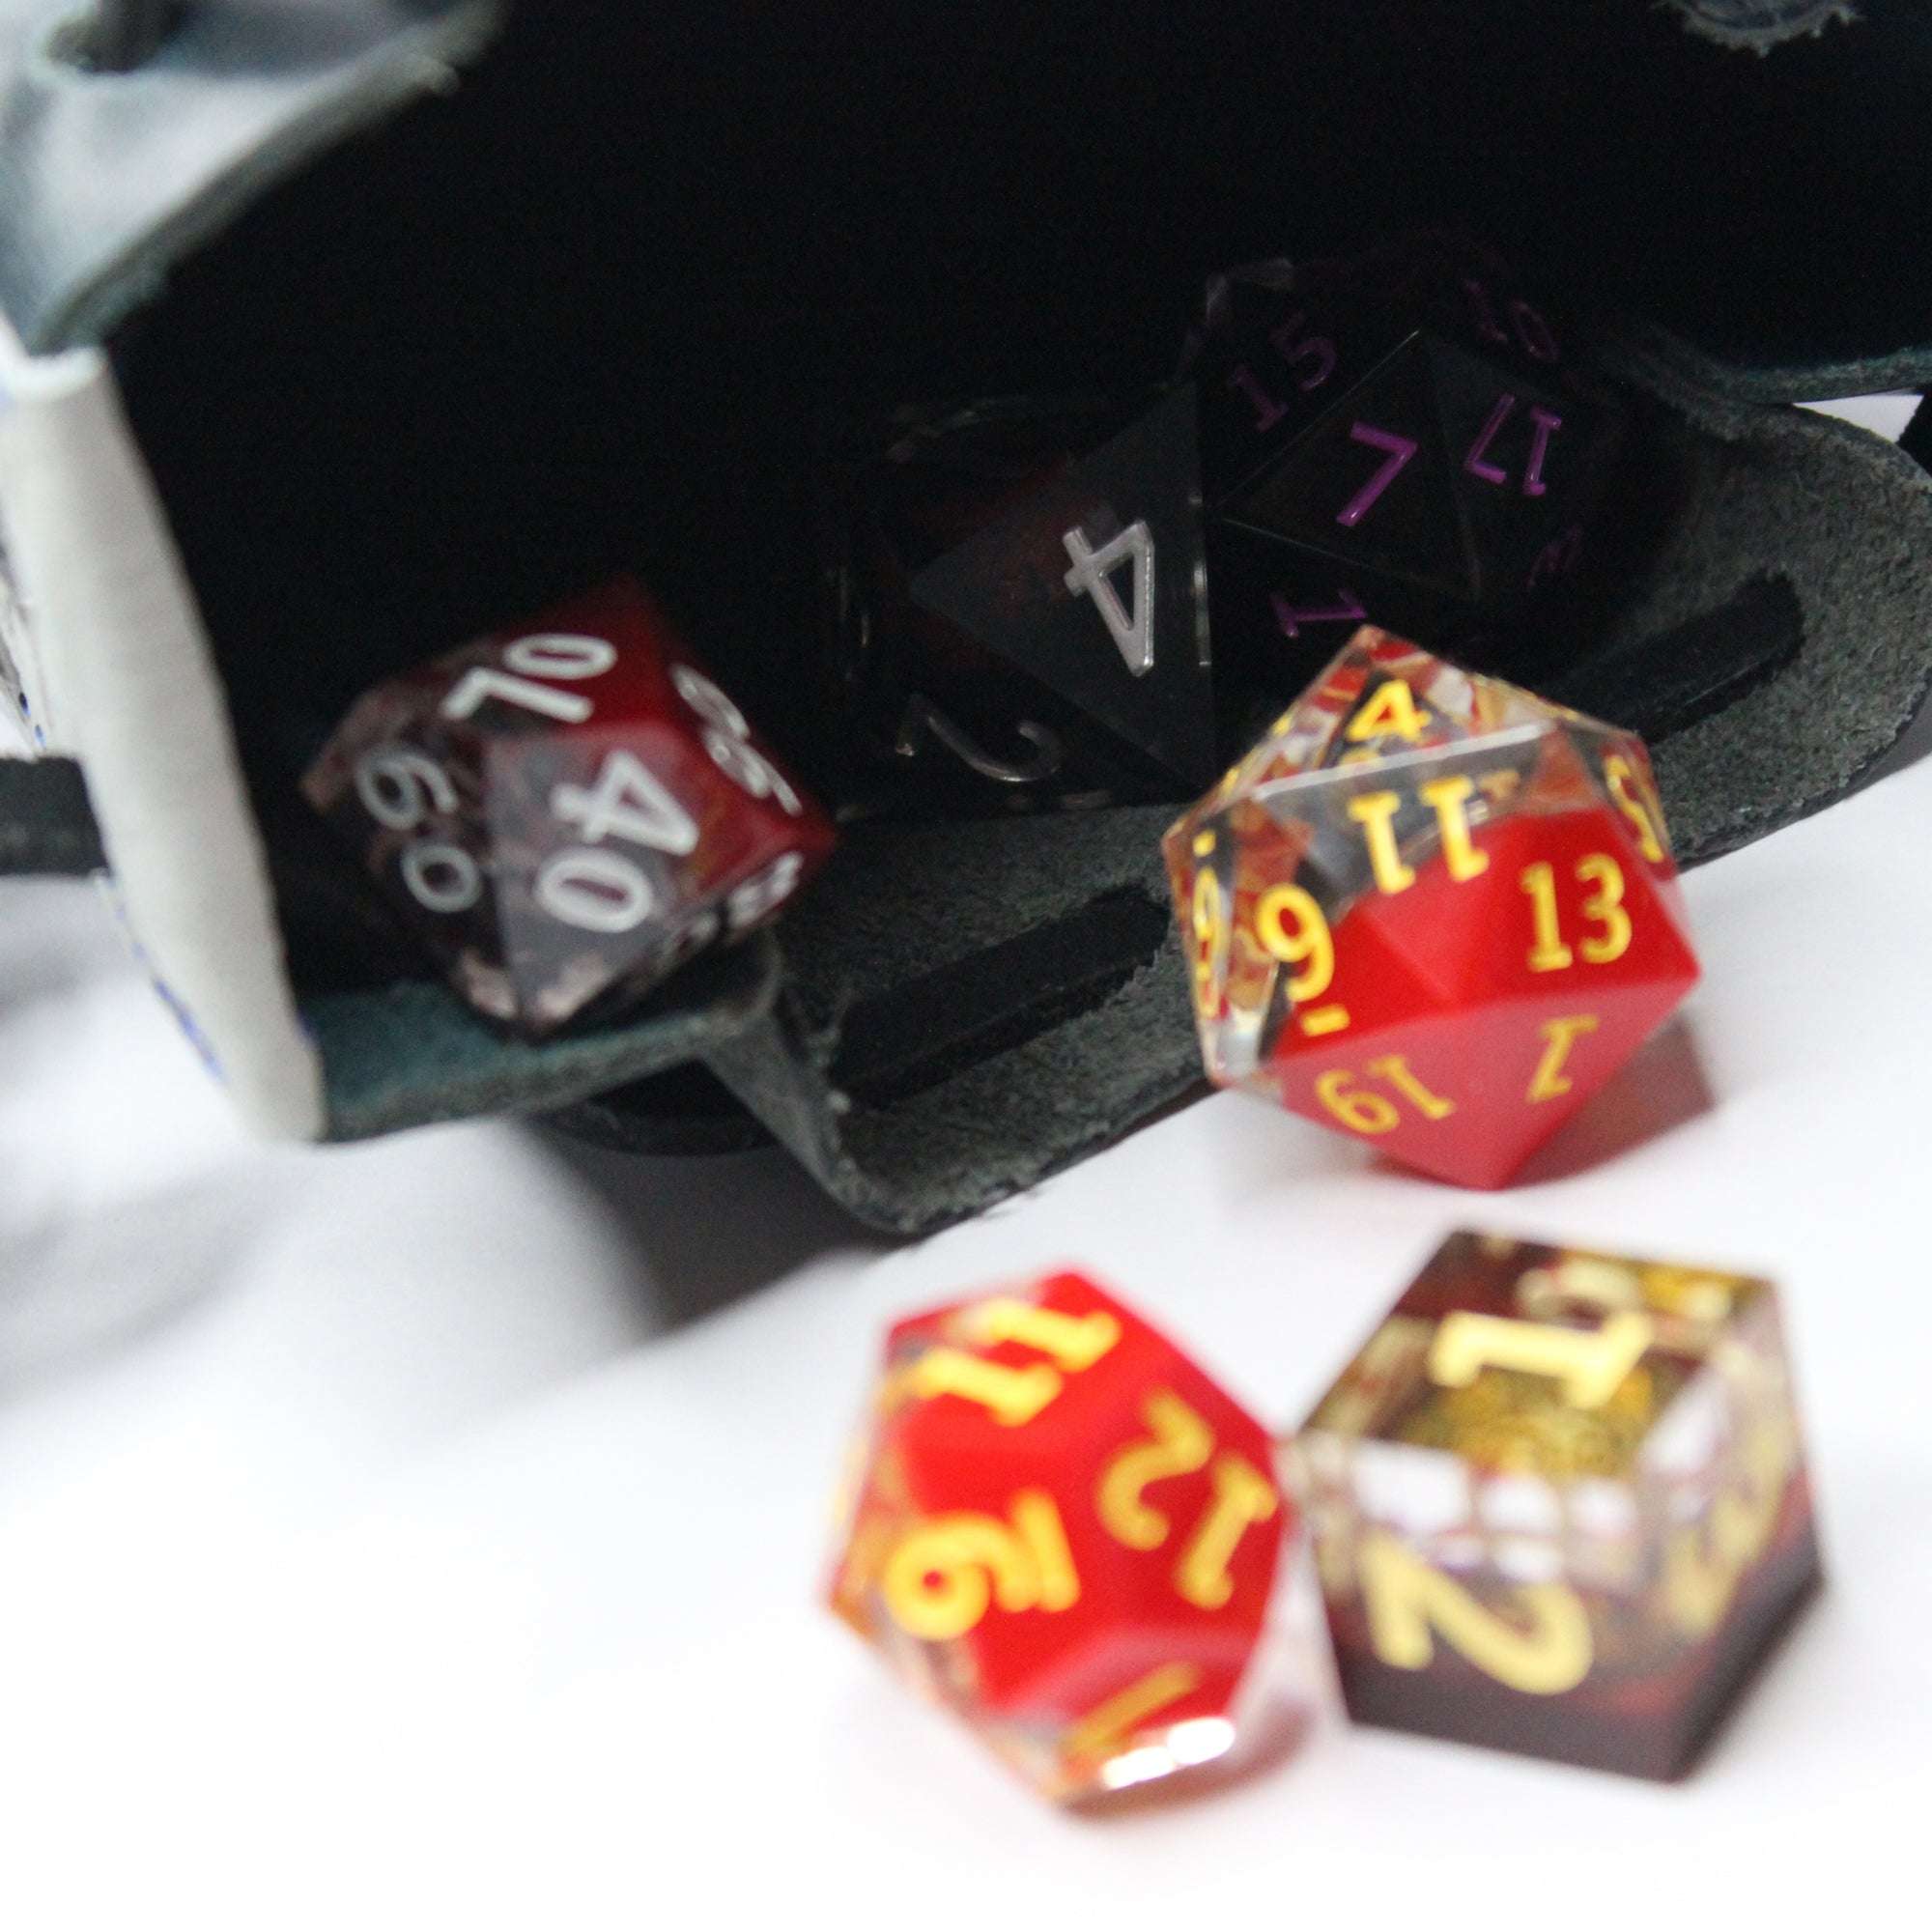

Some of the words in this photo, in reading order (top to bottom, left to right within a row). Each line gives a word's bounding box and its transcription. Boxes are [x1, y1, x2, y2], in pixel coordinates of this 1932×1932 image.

[1228, 309, 1339, 435] 15
[1337, 419, 1421, 527] 7
[1464, 393, 1564, 498] 17
[1062, 518, 1155, 678] 4
[1269, 585, 1369, 639] 1
[440, 633, 618, 724] 70
[1346, 677, 1432, 744] 4
[355, 740, 483, 914] 60
[532, 749, 700, 934] 40
[1347, 776, 1490, 895] 11
[1520, 853, 1633, 973] 13
[1314, 1054, 1457, 1135] 19
[1427, 1310, 1655, 1410] 1
[1094, 1384, 1280, 1610] 12
[1357, 1530, 1596, 1696] 2
